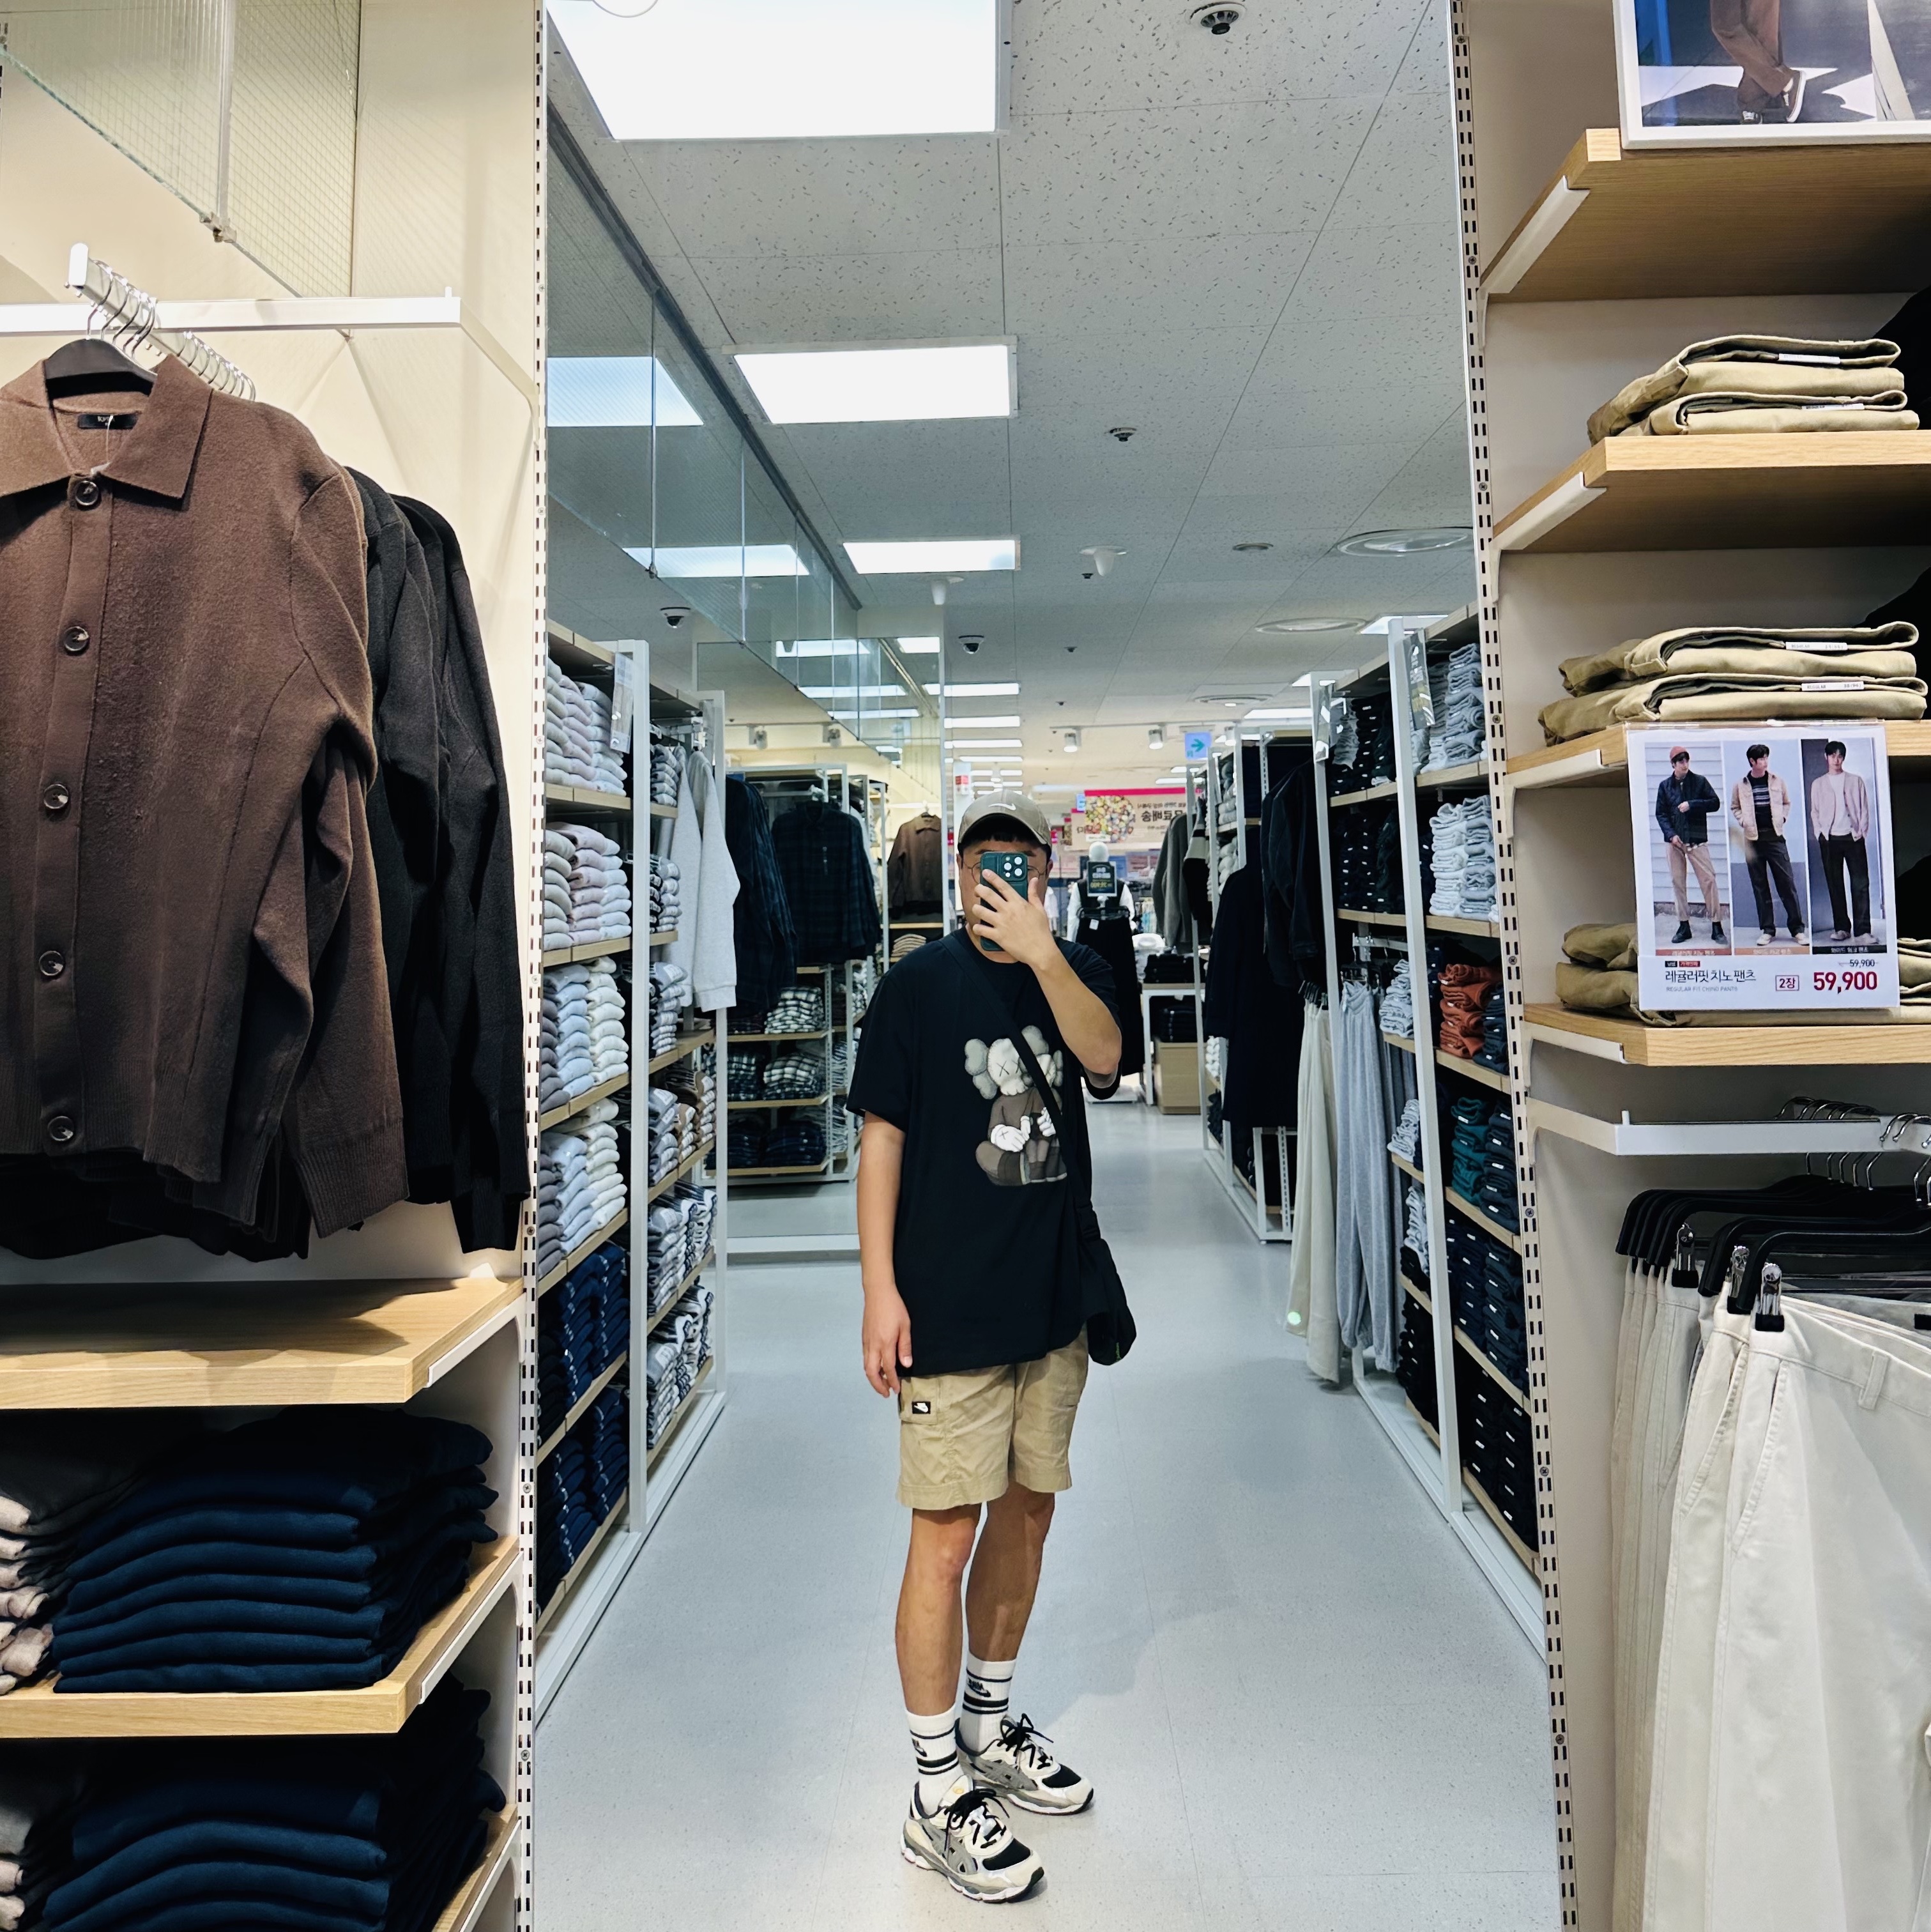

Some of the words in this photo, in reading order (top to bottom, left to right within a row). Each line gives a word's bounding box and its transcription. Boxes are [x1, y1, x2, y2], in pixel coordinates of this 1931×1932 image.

[1849, 959, 1875, 968] 59,900
[1665, 970, 1709, 983] 레귤러핏
[1711, 969, 1733, 983] 치노
[1734, 969, 1757, 983] 팬츠
[1813, 971, 1878, 994] 59,900
[1778, 977, 1796, 989] 2장
